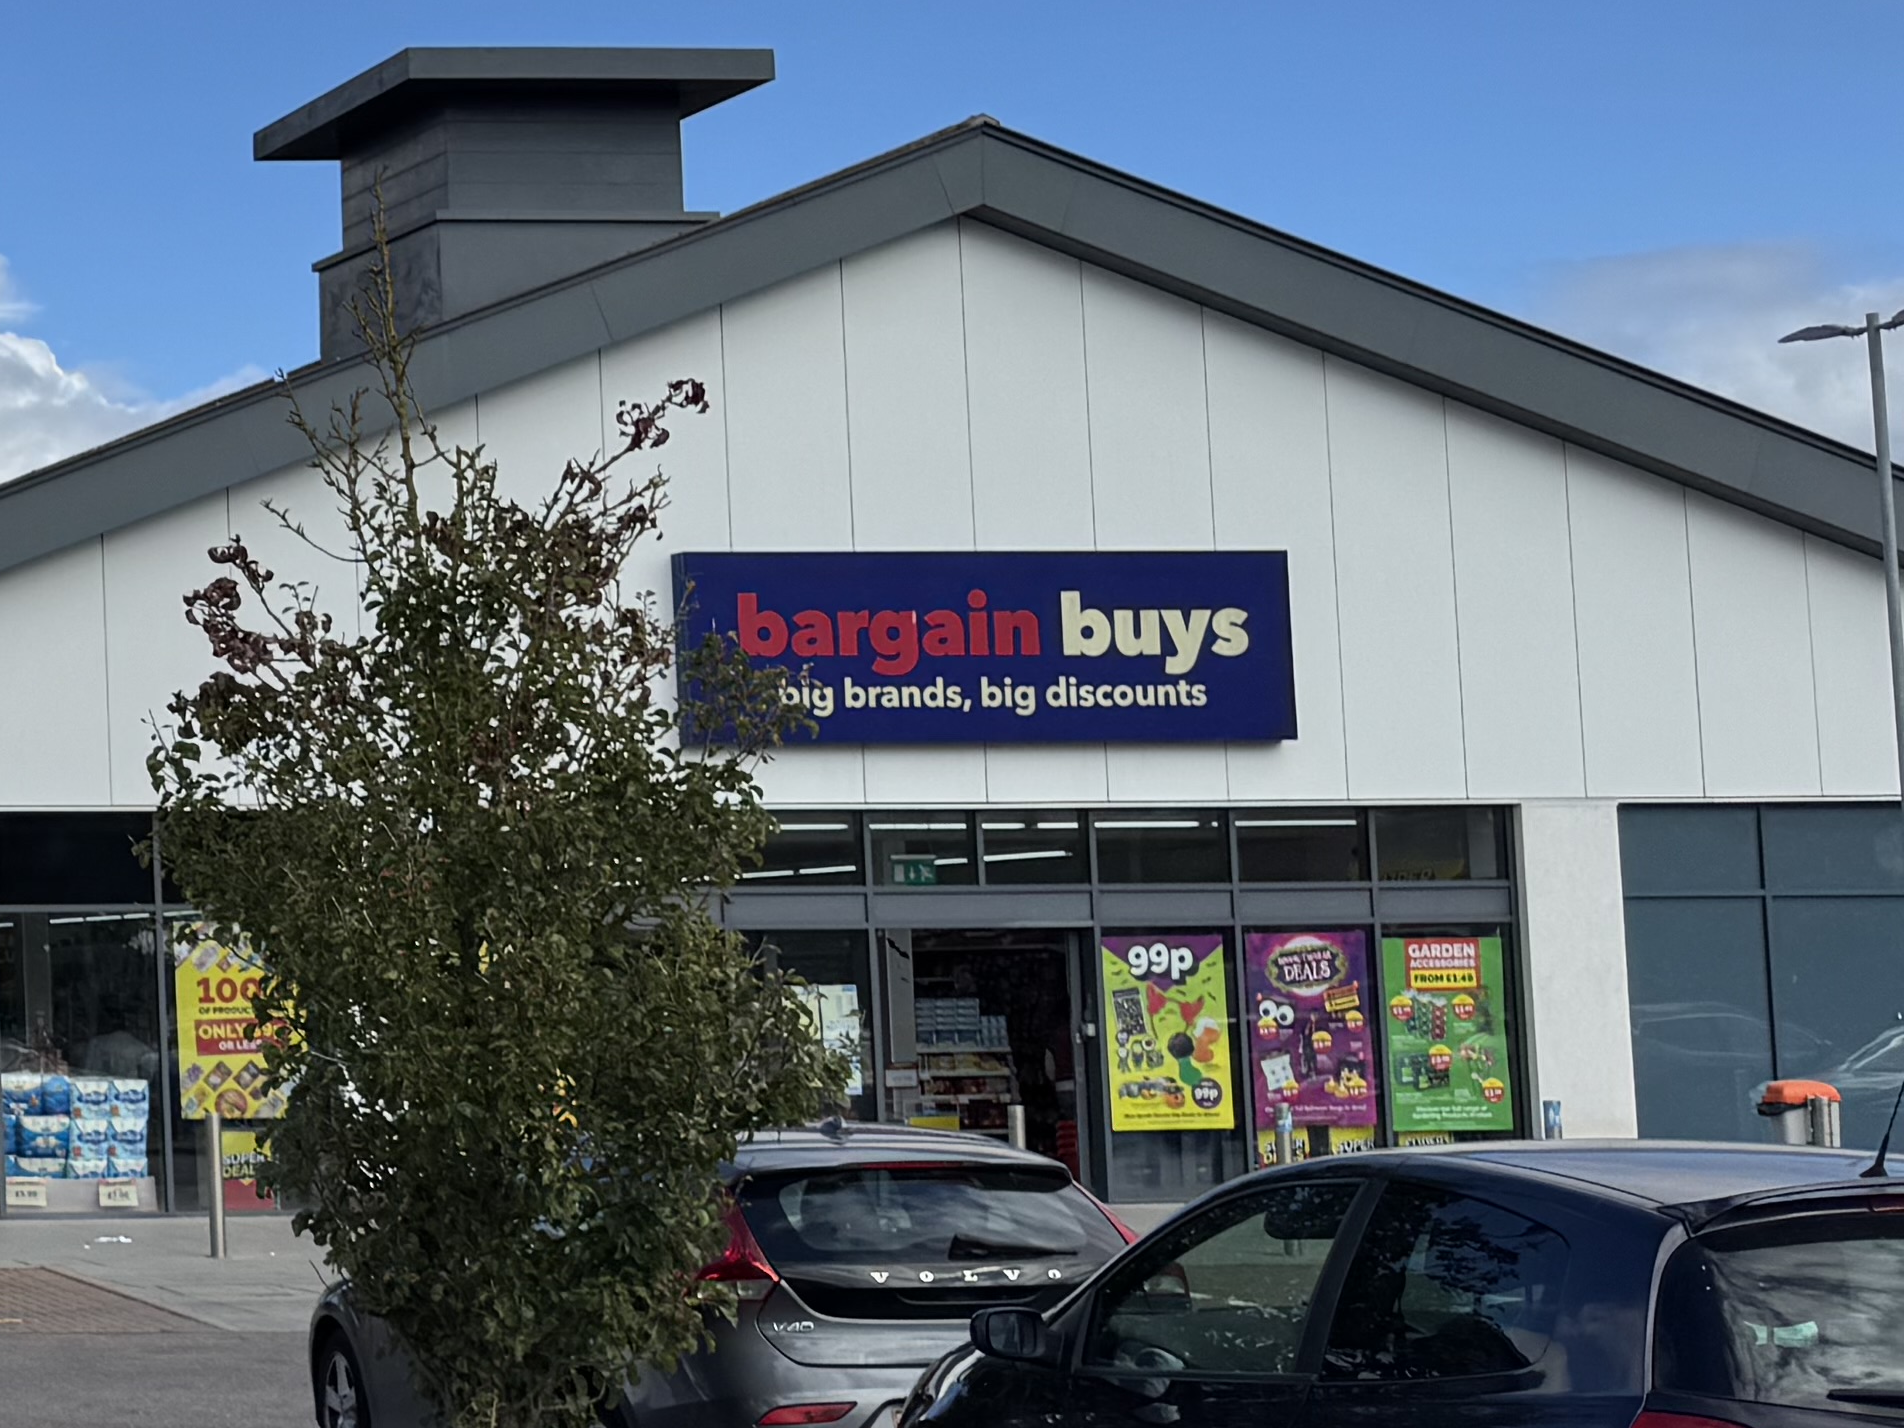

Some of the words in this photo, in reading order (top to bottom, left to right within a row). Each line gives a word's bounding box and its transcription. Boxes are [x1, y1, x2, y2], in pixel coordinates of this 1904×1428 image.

[737, 589, 1040, 676] bargain
[1060, 590, 1250, 675] buys
[780, 686, 834, 717] big
[845, 679, 972, 714] brands,
[980, 679, 1036, 716] big
[1045, 678, 1208, 709] discounts
[1408, 942, 1476, 959] GARDEN
[1127, 942, 1194, 980] 99p
[1409, 958, 1476, 969] ACCESSORIES
[1283, 960, 1331, 982] DEALS
[1414, 974, 1444, 984] FROM
[199, 1007, 210, 1015] OF
[218, 1041, 234, 1050] OR
[870, 1269, 1062, 1283] VOLVO
[773, 1322, 814, 1332] V40
